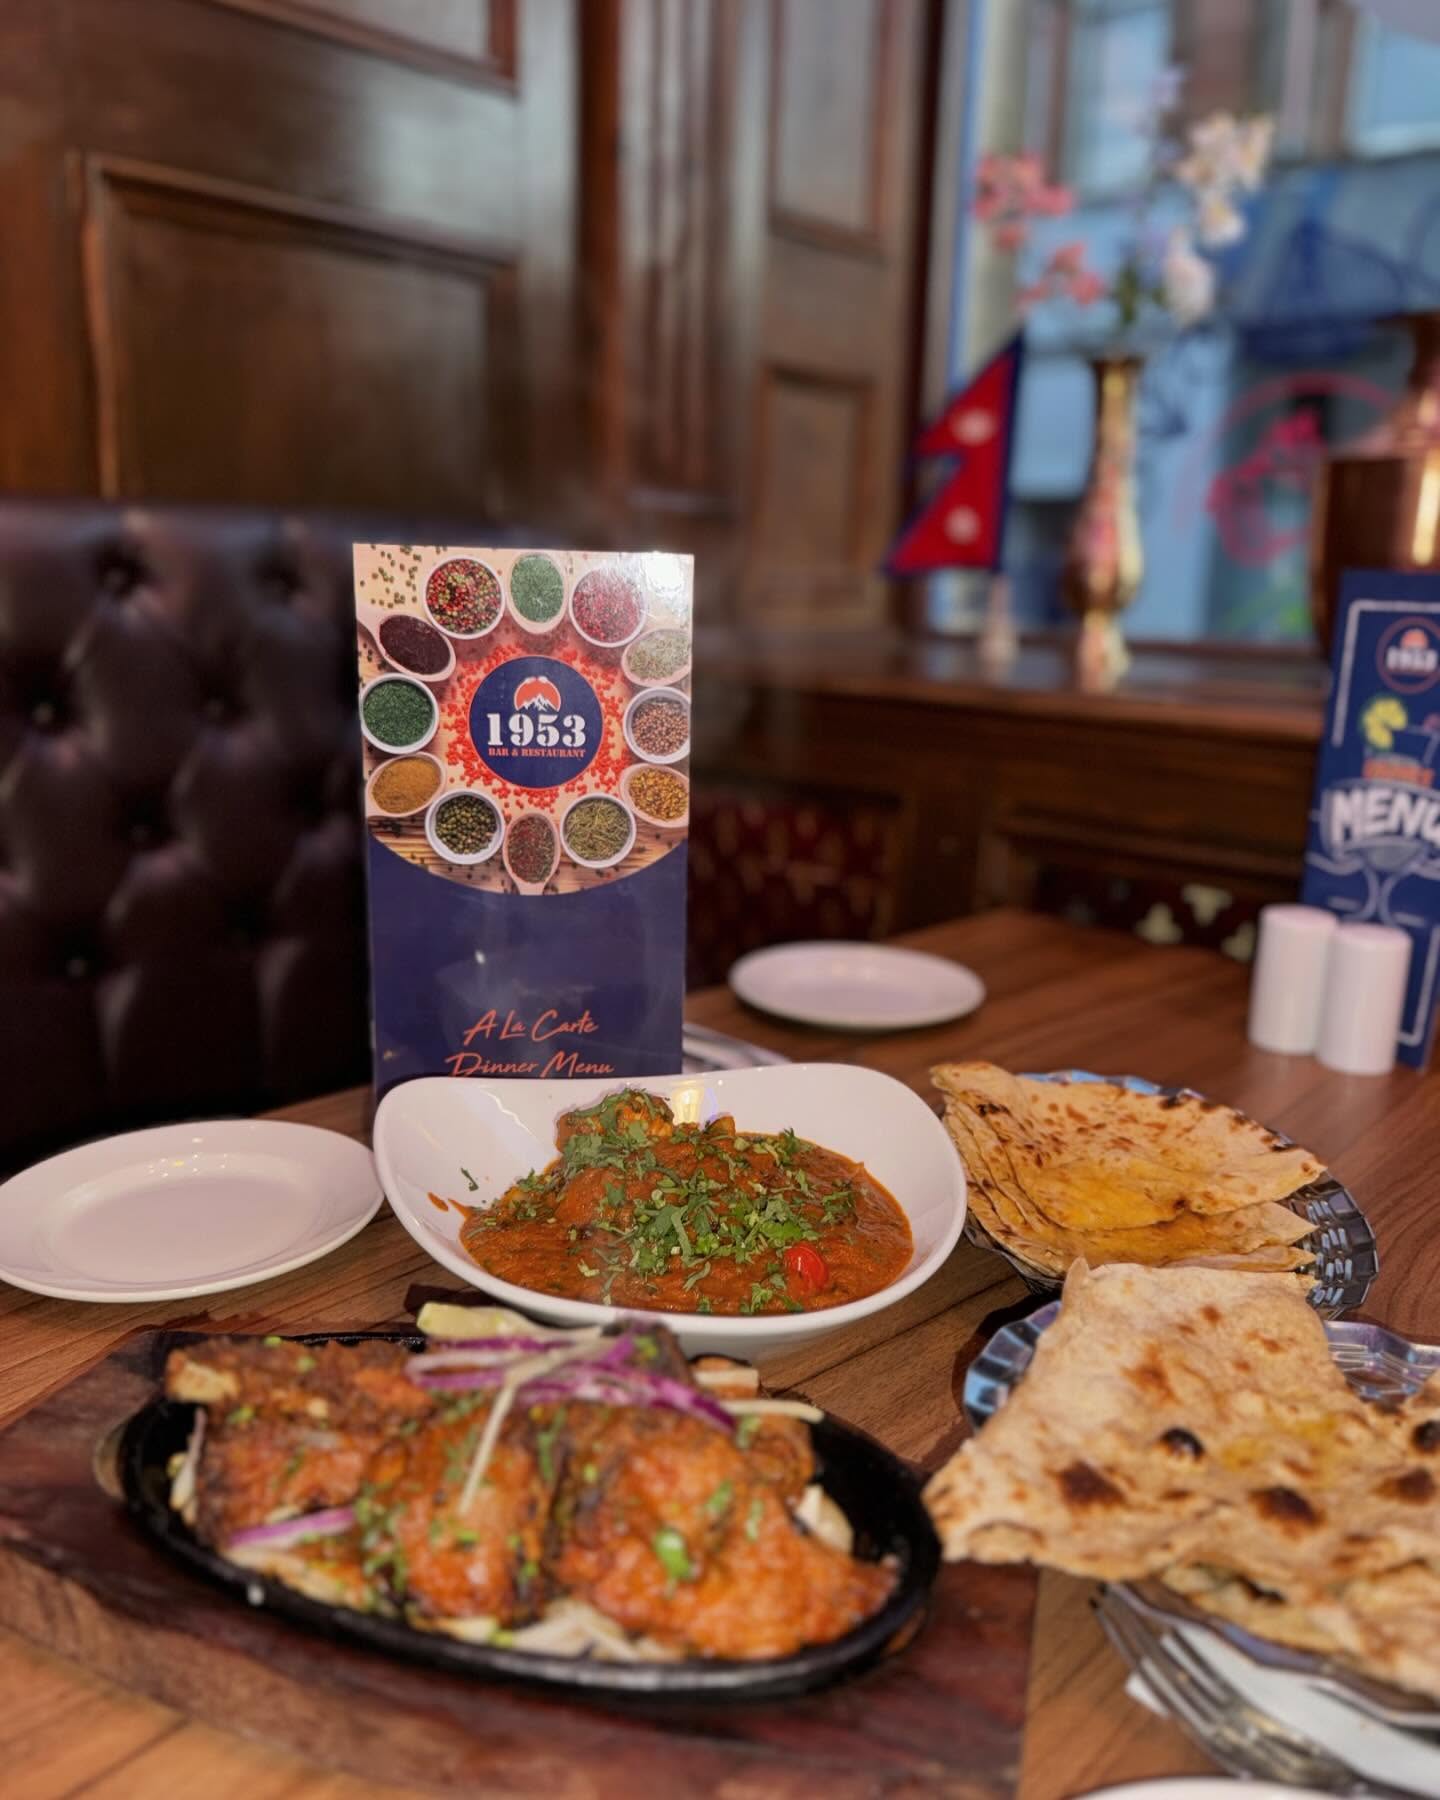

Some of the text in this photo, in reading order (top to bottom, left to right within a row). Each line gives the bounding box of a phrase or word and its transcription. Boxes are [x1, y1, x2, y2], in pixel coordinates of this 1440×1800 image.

[486, 712, 586, 748] 1953
[488, 747, 586, 758] BAR & RESTAURANT
[463, 1008, 599, 1046] A La Carte
[444, 1049, 614, 1078] Dinner Menu
